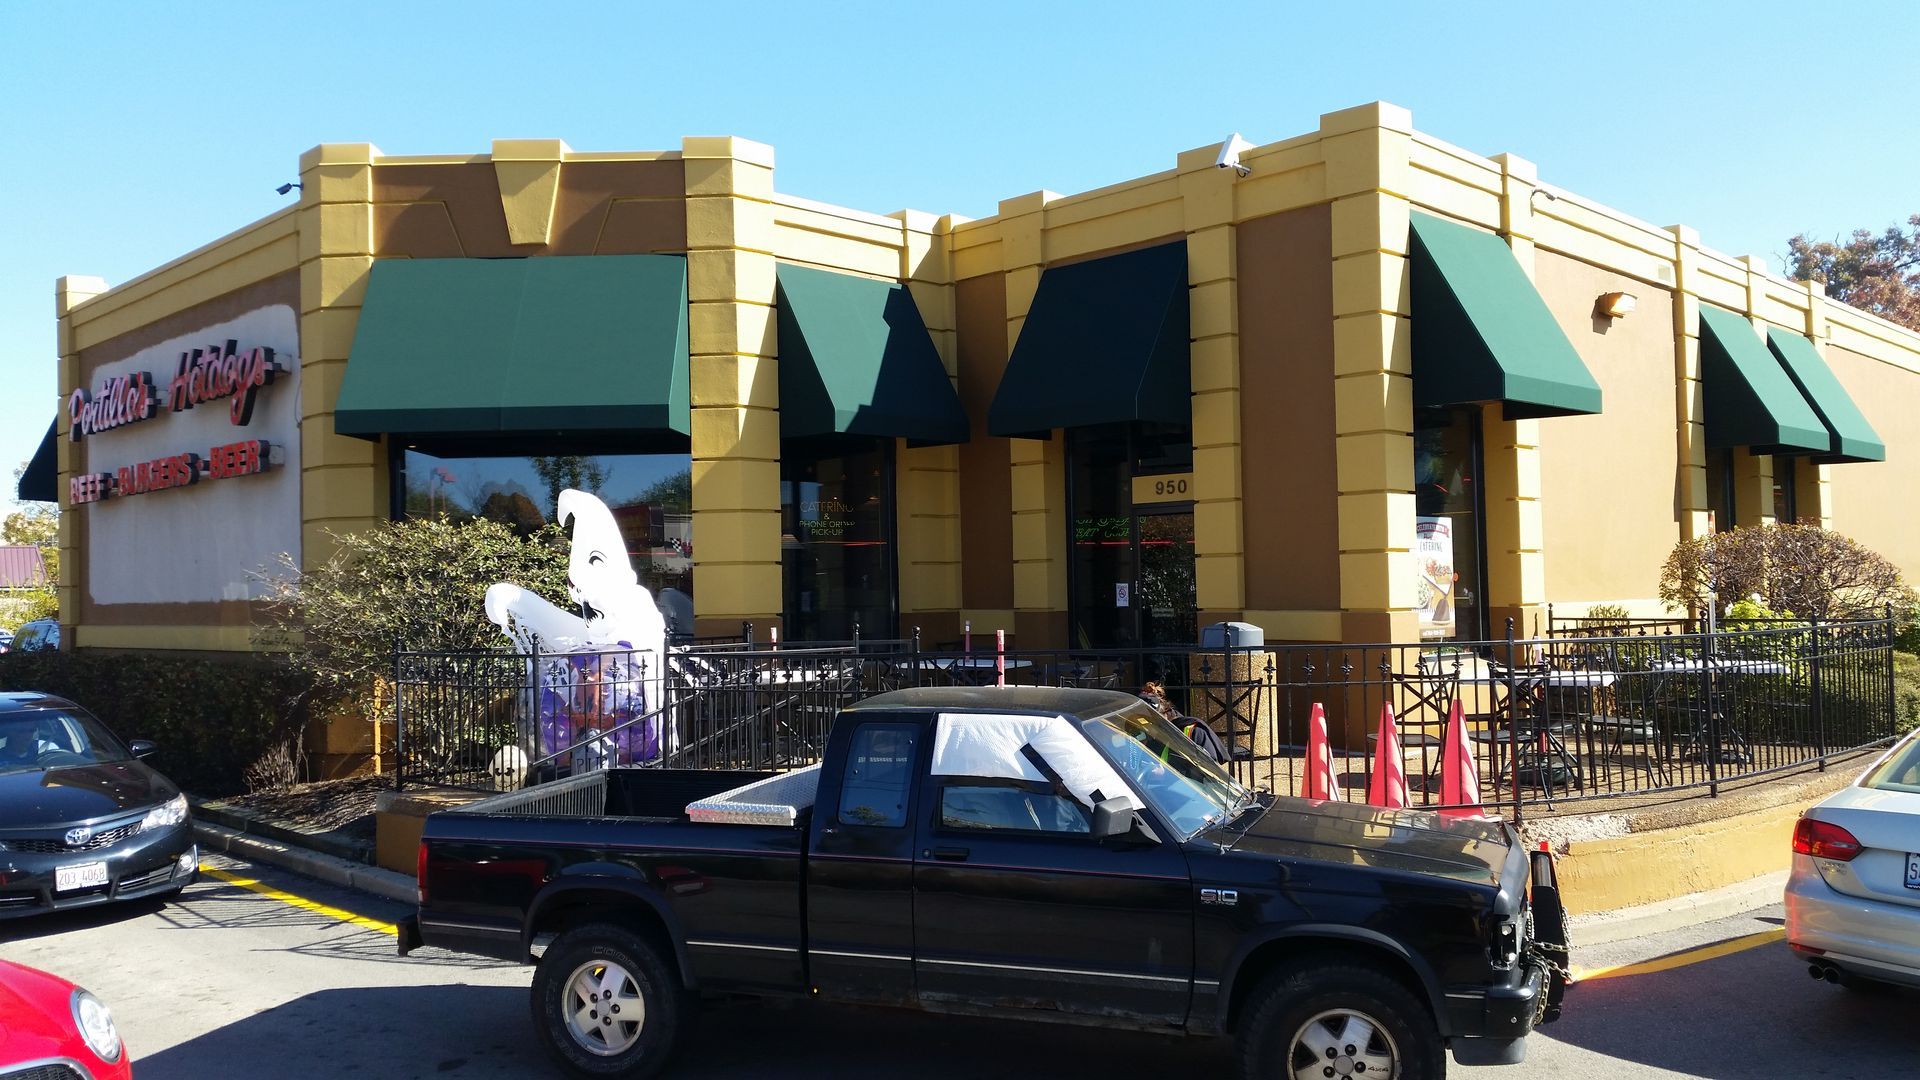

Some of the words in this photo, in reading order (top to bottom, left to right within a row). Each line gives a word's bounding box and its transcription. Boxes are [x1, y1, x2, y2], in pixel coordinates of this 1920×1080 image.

[70, 472, 109, 505] BEEF
[117, 453, 198, 497] BURGERS
[210, 440, 269, 480] BEER
[1155, 480, 1187, 495] 950
[799, 520, 827, 528] PHONE
[811, 528, 844, 536] PICK-UP
[1200, 888, 1238, 902] S10
